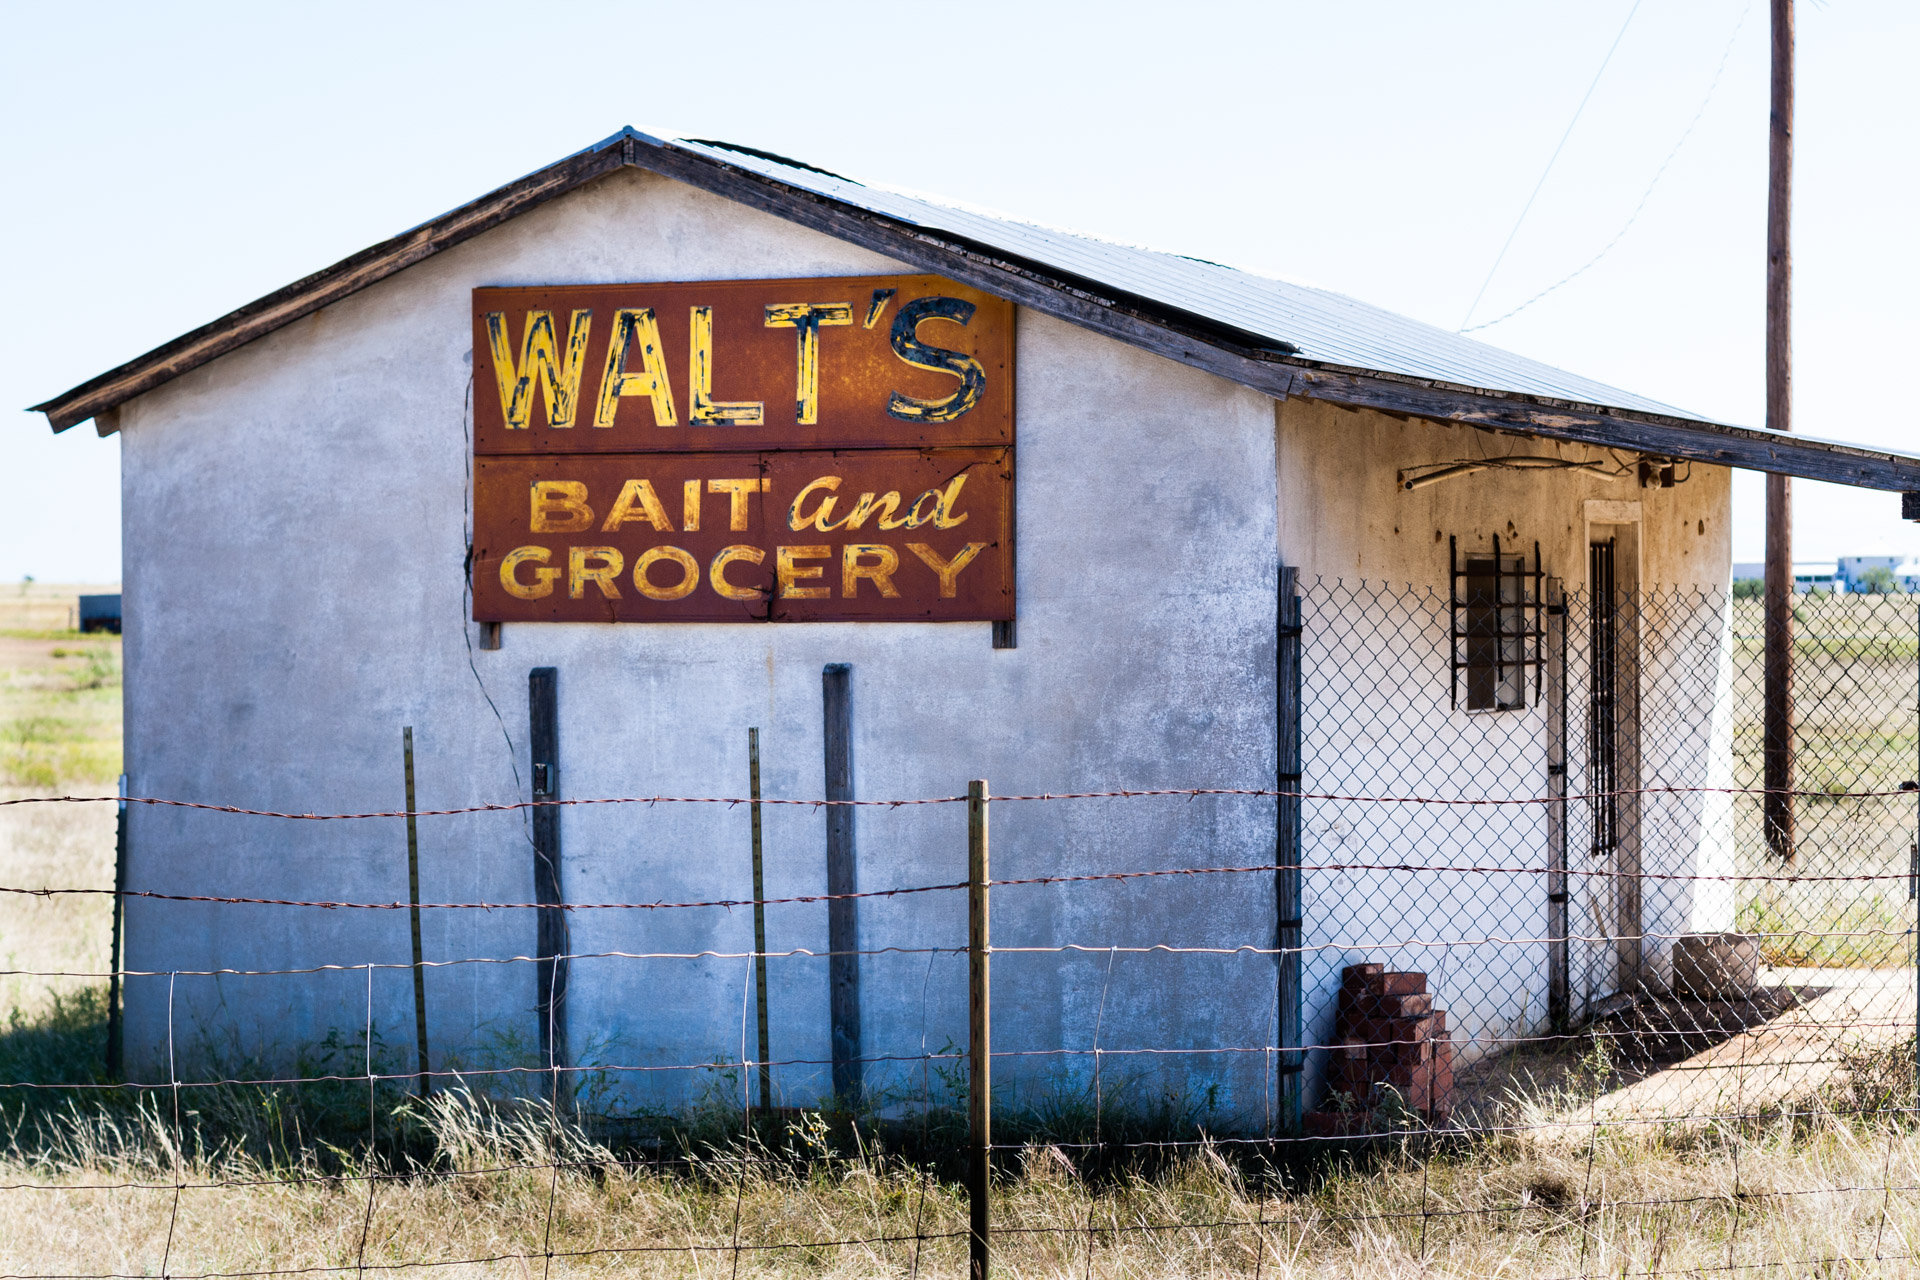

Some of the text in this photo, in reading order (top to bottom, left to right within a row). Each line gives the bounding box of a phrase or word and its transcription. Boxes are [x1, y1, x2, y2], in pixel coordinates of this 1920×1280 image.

[485, 288, 987, 430] WALT'S
[529, 473, 970, 534] BAIT and
[499, 542, 988, 600] GROCERY
